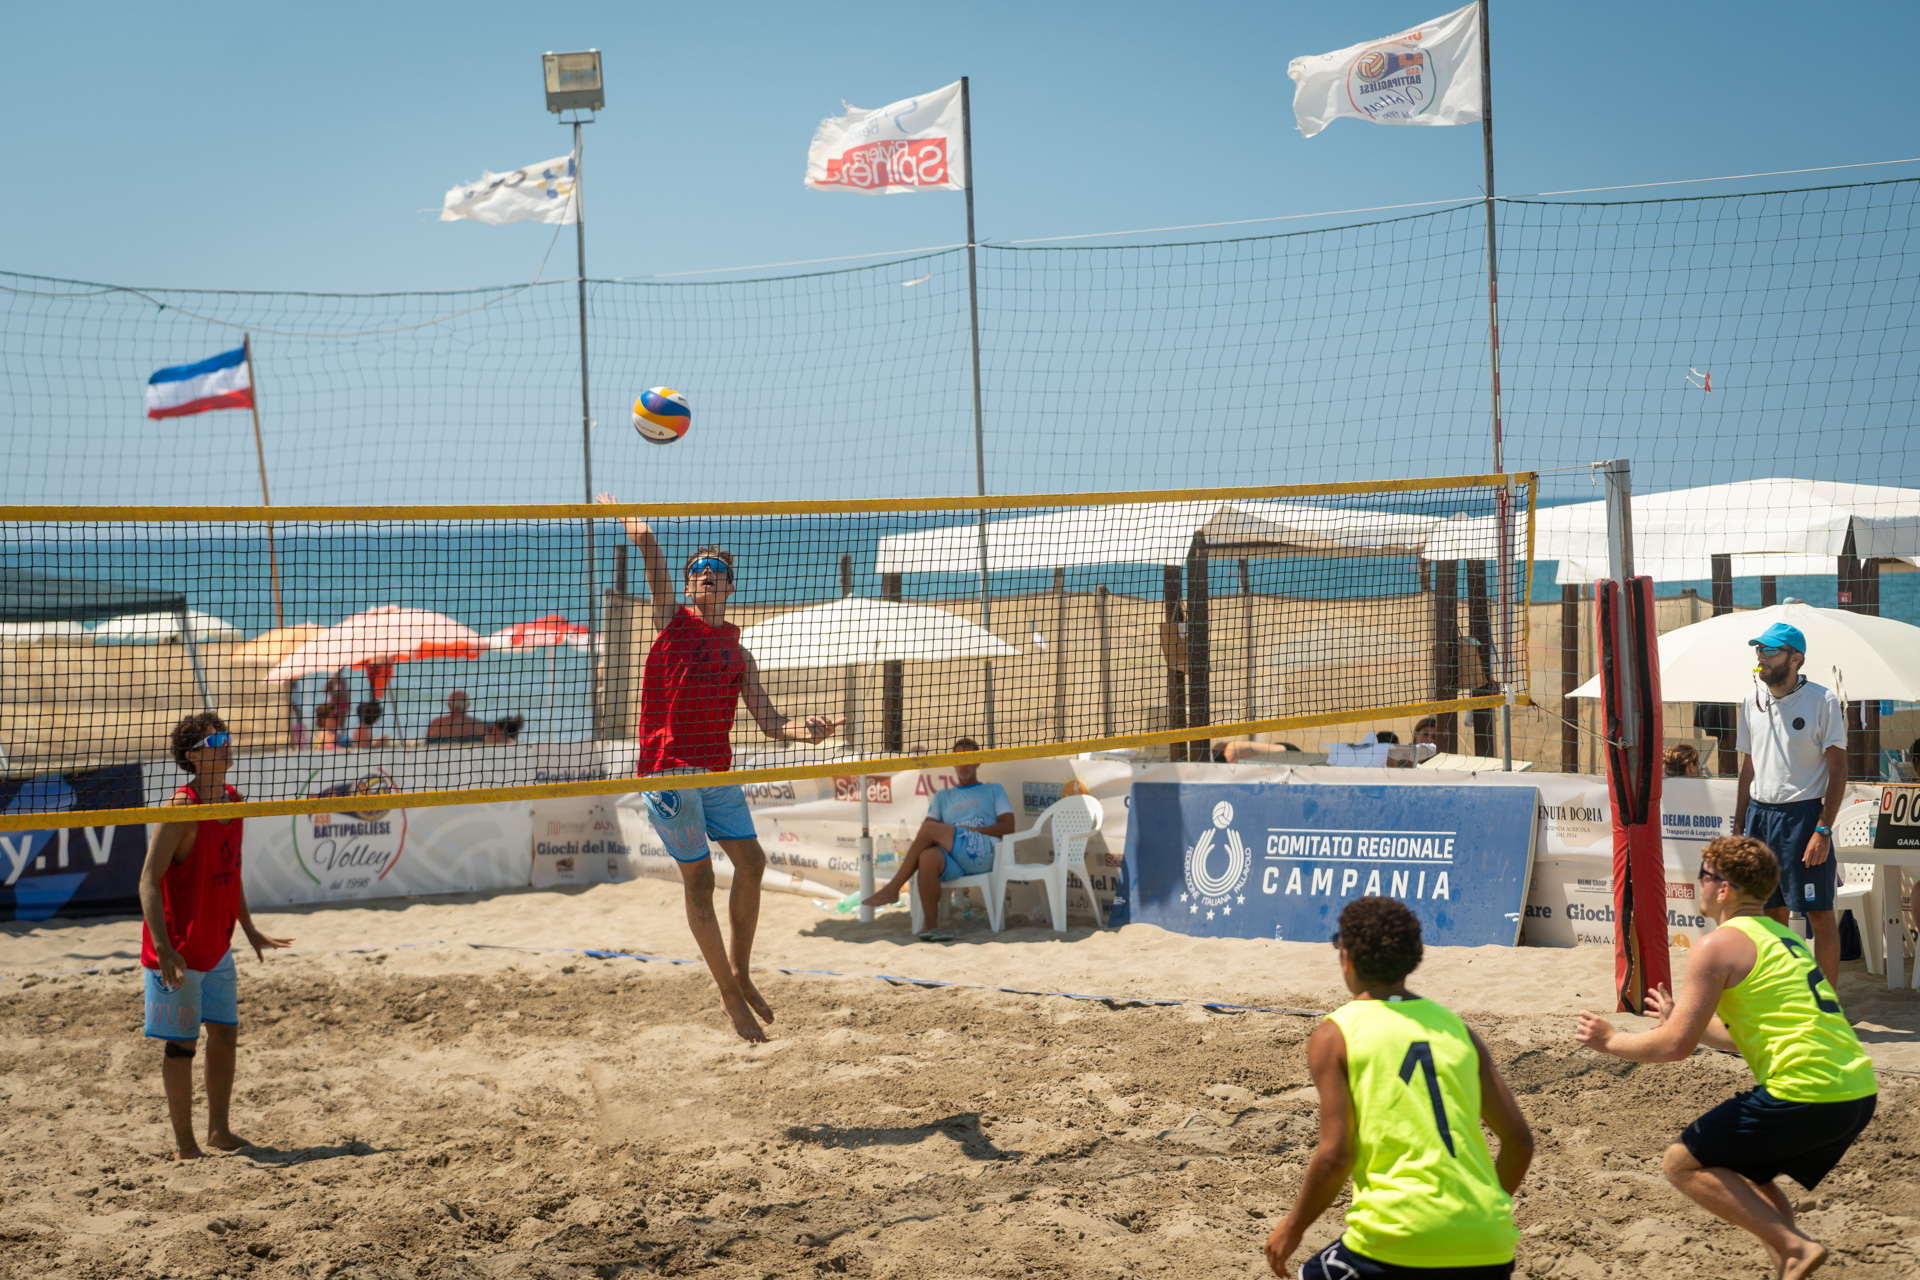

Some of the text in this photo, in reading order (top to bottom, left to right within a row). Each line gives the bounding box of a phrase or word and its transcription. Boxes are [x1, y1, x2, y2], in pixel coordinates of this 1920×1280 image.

[741, 780, 796, 805] nipolSai
[836, 778, 891, 801] Spieta
[1024, 794, 1063, 808] BEAC
[1883, 791, 1893, 811] 0
[1537, 806, 1603, 822] ENUTA DORIA
[1662, 814, 1723, 829] DELMA GROUP
[314, 821, 392, 839] BATTIPAGLIESE
[1666, 828, 1690, 836] Trasporti
[1695, 829, 1720, 837] Logistica
[537, 840, 631, 856] Giochi del Mare
[640, 843, 671, 857] Gioc
[1266, 834, 1455, 859] COMITATO REGIONALE
[1896, 838, 1920, 846] GANA
[0, 825, 116, 887] y.TV
[314, 836, 392, 873] Volley
[770, 852, 819, 869] del Mare
[828, 857, 860, 872] Gioc
[1184, 846, 1200, 900] FEDERAZIONE
[1233, 847, 1252, 894] PALLAVOLO
[1262, 866, 1450, 900] CAMPANIA
[1201, 893, 1232, 906] ITALIANA
[1666, 886, 1694, 899] ineta
[1525, 903, 1615, 923] are Gioch
[1667, 910, 1705, 928] Mare
[1577, 933, 1616, 946] FAMA
[1399, 1041, 1457, 1160] 1
